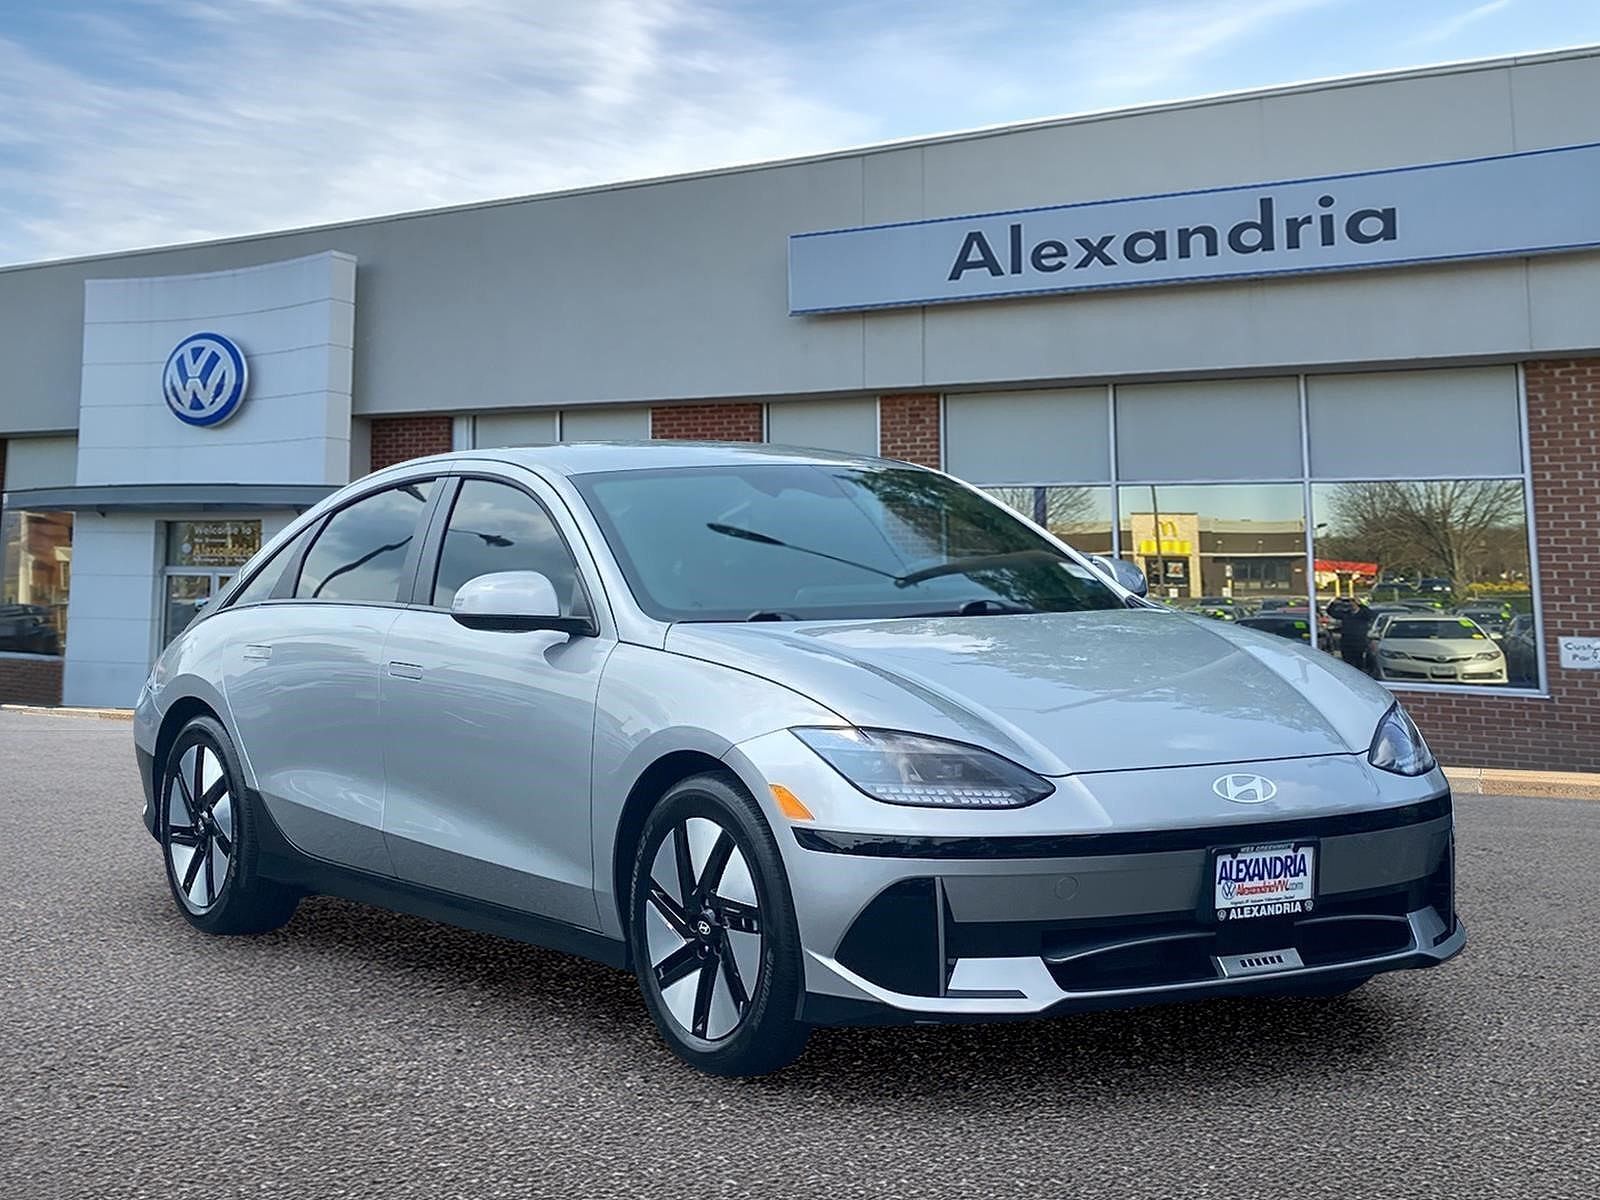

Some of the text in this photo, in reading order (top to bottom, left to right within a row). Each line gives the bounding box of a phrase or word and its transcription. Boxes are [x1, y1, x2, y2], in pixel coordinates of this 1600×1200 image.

[947, 195, 1398, 281] Alexandria
[1218, 853, 1308, 885] ALEXANDRIA
[1229, 901, 1302, 920] ALEXANDRIA
